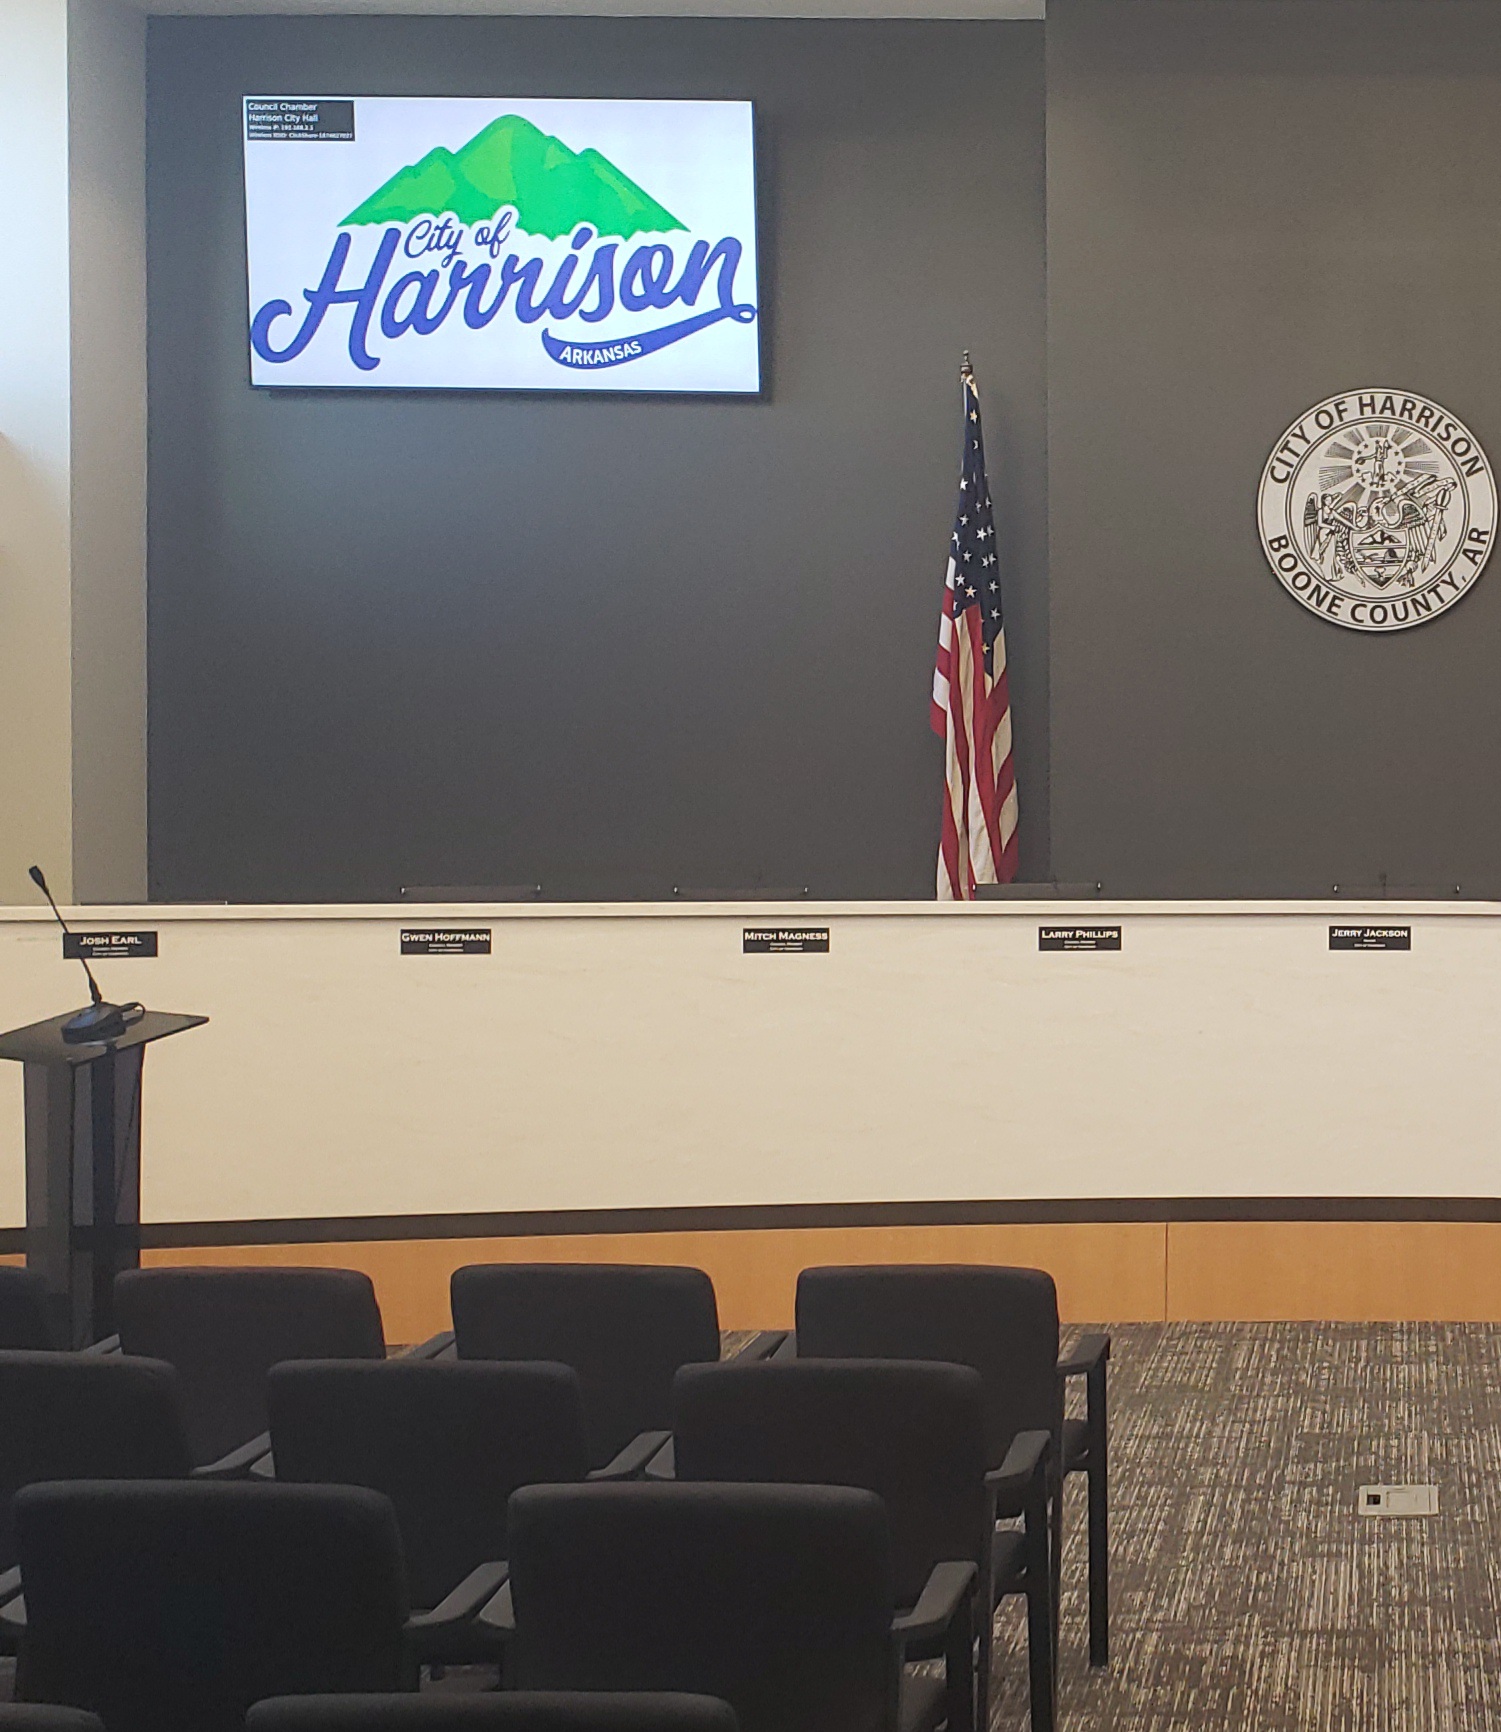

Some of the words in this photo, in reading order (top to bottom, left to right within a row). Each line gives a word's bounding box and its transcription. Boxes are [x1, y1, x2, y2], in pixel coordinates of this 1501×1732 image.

[248, 103, 278, 111] Council
[280, 103, 317, 111] Chamber
[249, 114, 282, 122] Harrison
[284, 114, 300, 123] City
[302, 114, 319, 122] Hall
[404, 218, 463, 268] City
[475, 211, 512, 259] of
[252, 228, 757, 370] Harrison
[559, 341, 642, 365] ARKANSAS
[1269, 425, 1312, 484] CITY
[1314, 400, 1349, 430] OF
[1358, 395, 1485, 478] HARRISON
[1269, 534, 1345, 616] BOONE
[1350, 571, 1466, 624] COUNTY,
[1462, 527, 1490, 566] AR
[402, 932, 432, 942] GWEN
[434, 932, 490, 942] HOFFMANN
[744, 932, 776, 940] MITCH
[778, 931, 828, 940] MAGNESS
[1041, 930, 1073, 938] LARRY
[1075, 930, 1118, 938] PHILLIPS
[1332, 929, 1362, 937] JERRY
[1364, 929, 1408, 937] JACKSON
[80, 936, 109, 945] JOSH
[111, 935, 142, 945] EARL
